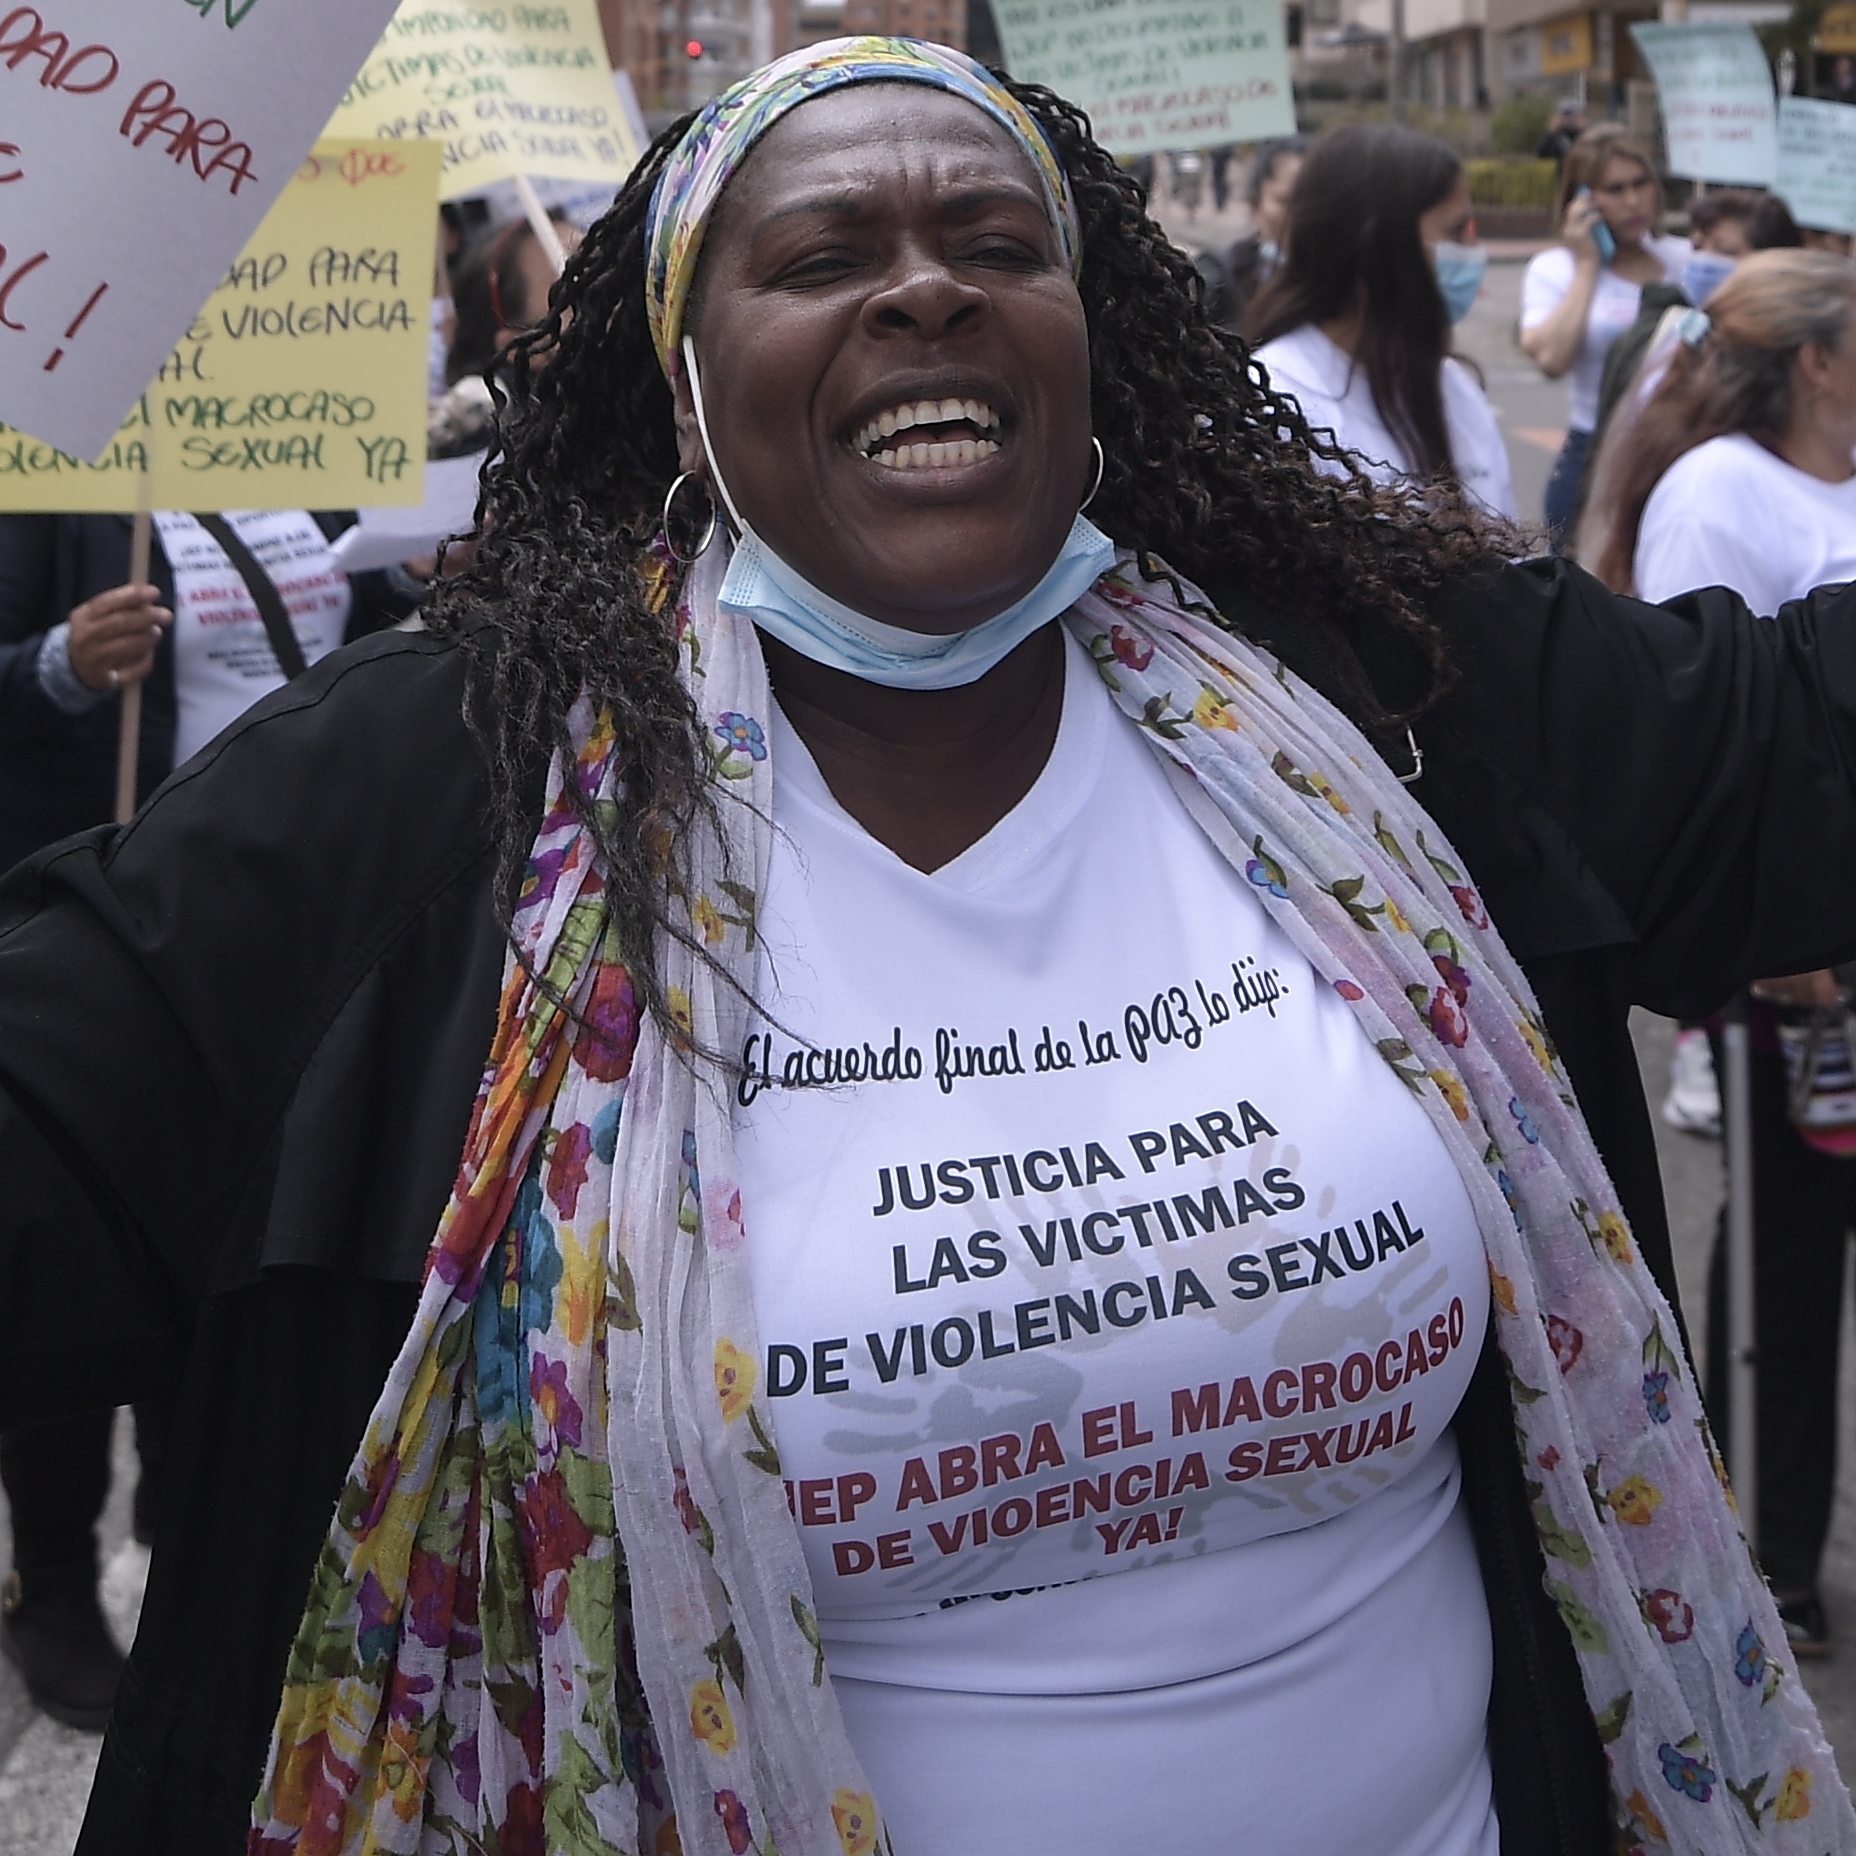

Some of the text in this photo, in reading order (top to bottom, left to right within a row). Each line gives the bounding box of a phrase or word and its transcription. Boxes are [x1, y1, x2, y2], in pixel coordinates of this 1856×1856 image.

[119, 78, 259, 196] PARA
[310, 247, 400, 289] PARA
[164, 390, 378, 429] MACROCASO
[356, 437, 412, 483] YA
[781, 1026, 923, 1088] acuerdo
[934, 1027, 1026, 1095] final
[1034, 1025, 1077, 1073] de
[1078, 1020, 1122, 1066] la
[1194, 978, 1231, 1028] lo
[872, 1098, 1280, 1218] JUSTICIA PARA
[890, 1165, 1307, 1295] LAS VICTIMAS
[765, 1200, 1426, 1399] DE VIOLENCIA SEXUAL
[895, 1430, 1060, 1514] ABRA
[1082, 1408, 1155, 1462] EL
[1169, 1296, 1466, 1438] MACROCASO
[832, 1403, 1418, 1577] DE VIOENCIA SEXUAL
[1095, 1506, 1184, 1557] YA!
